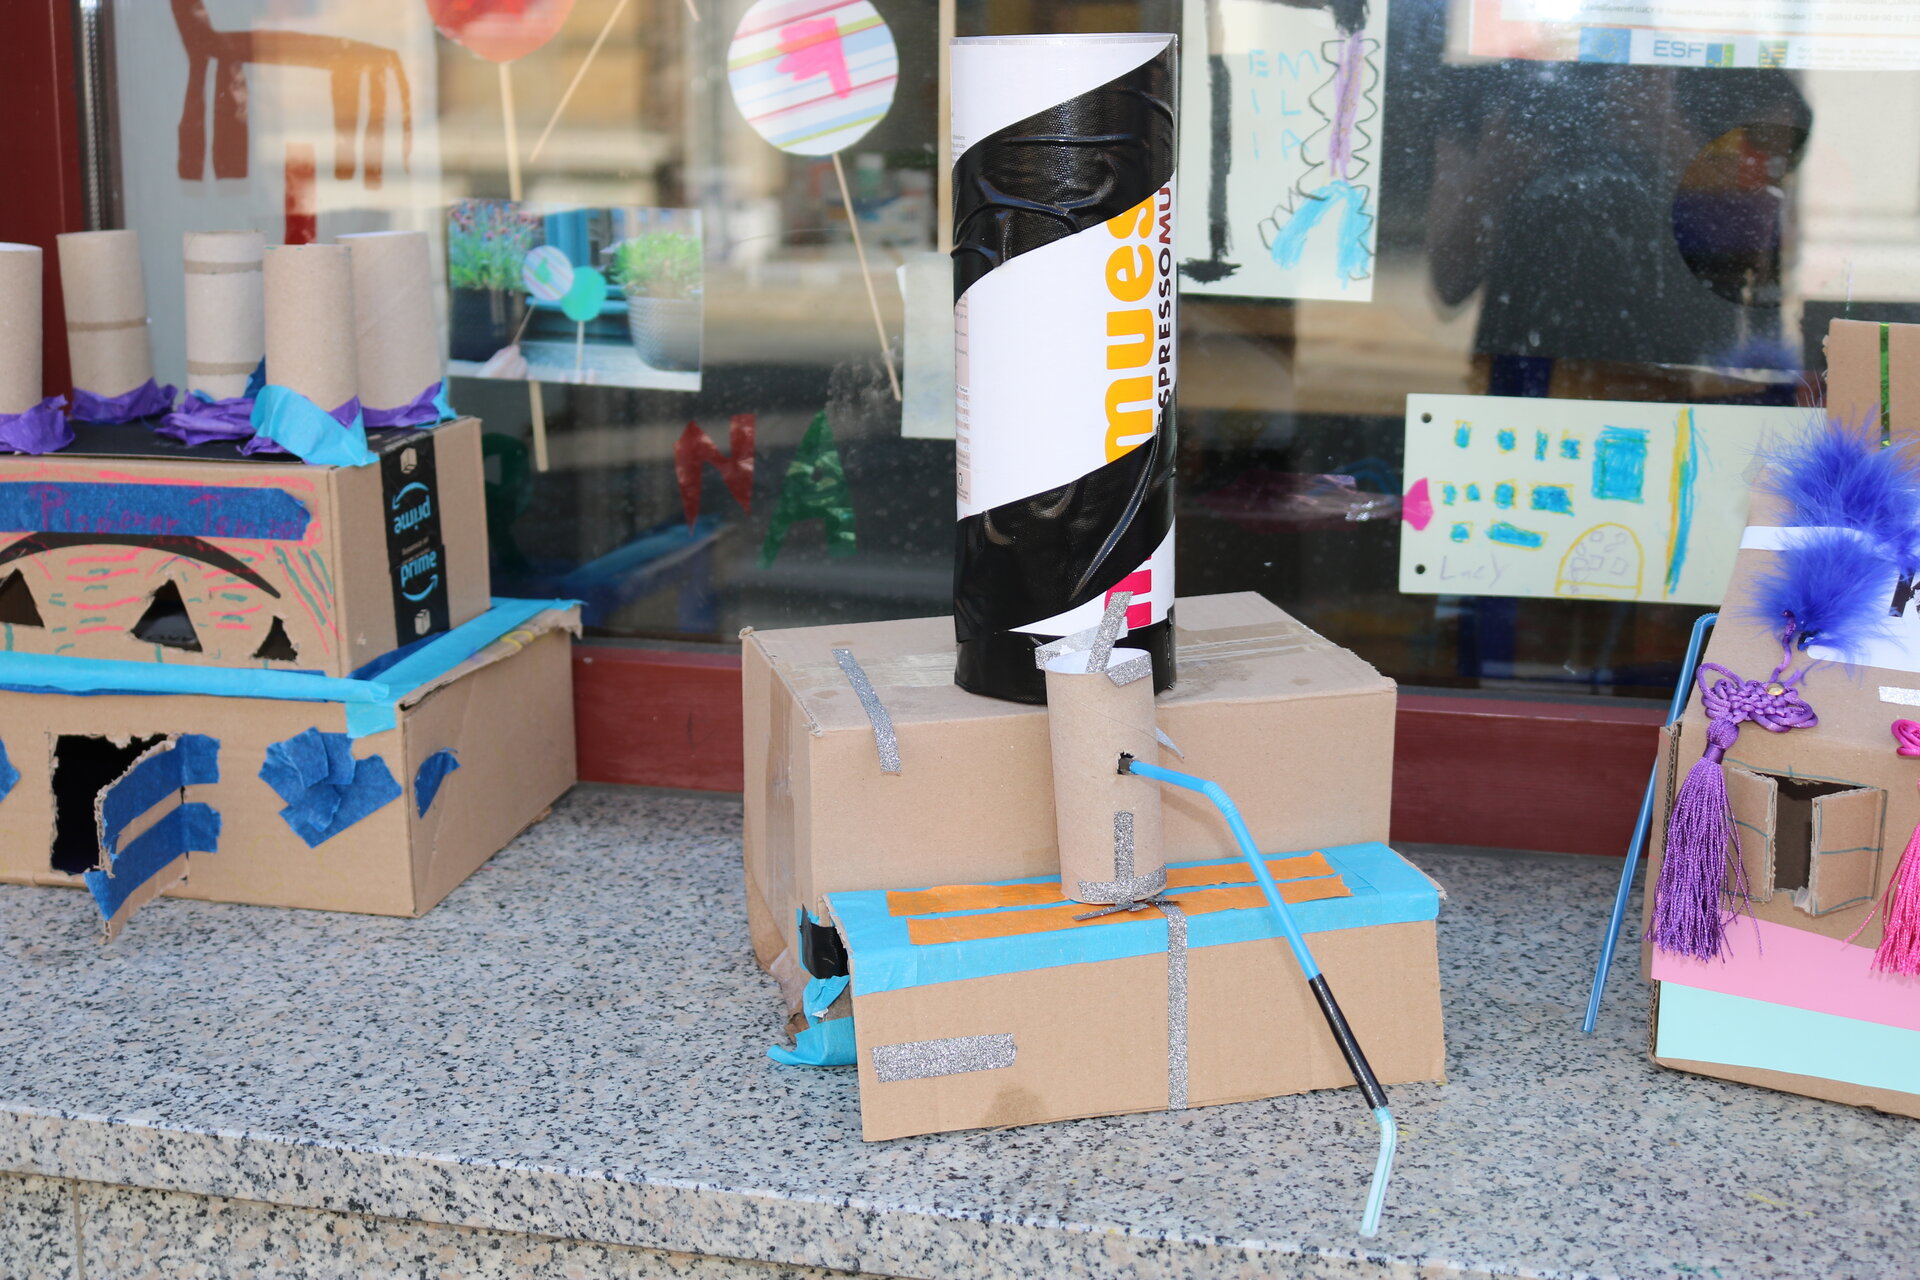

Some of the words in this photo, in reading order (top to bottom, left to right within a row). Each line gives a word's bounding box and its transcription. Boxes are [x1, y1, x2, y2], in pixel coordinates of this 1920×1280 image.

[1653, 40, 1704, 58] ESF
[393, 495, 431, 535] prime
[400, 550, 437, 589] prime
